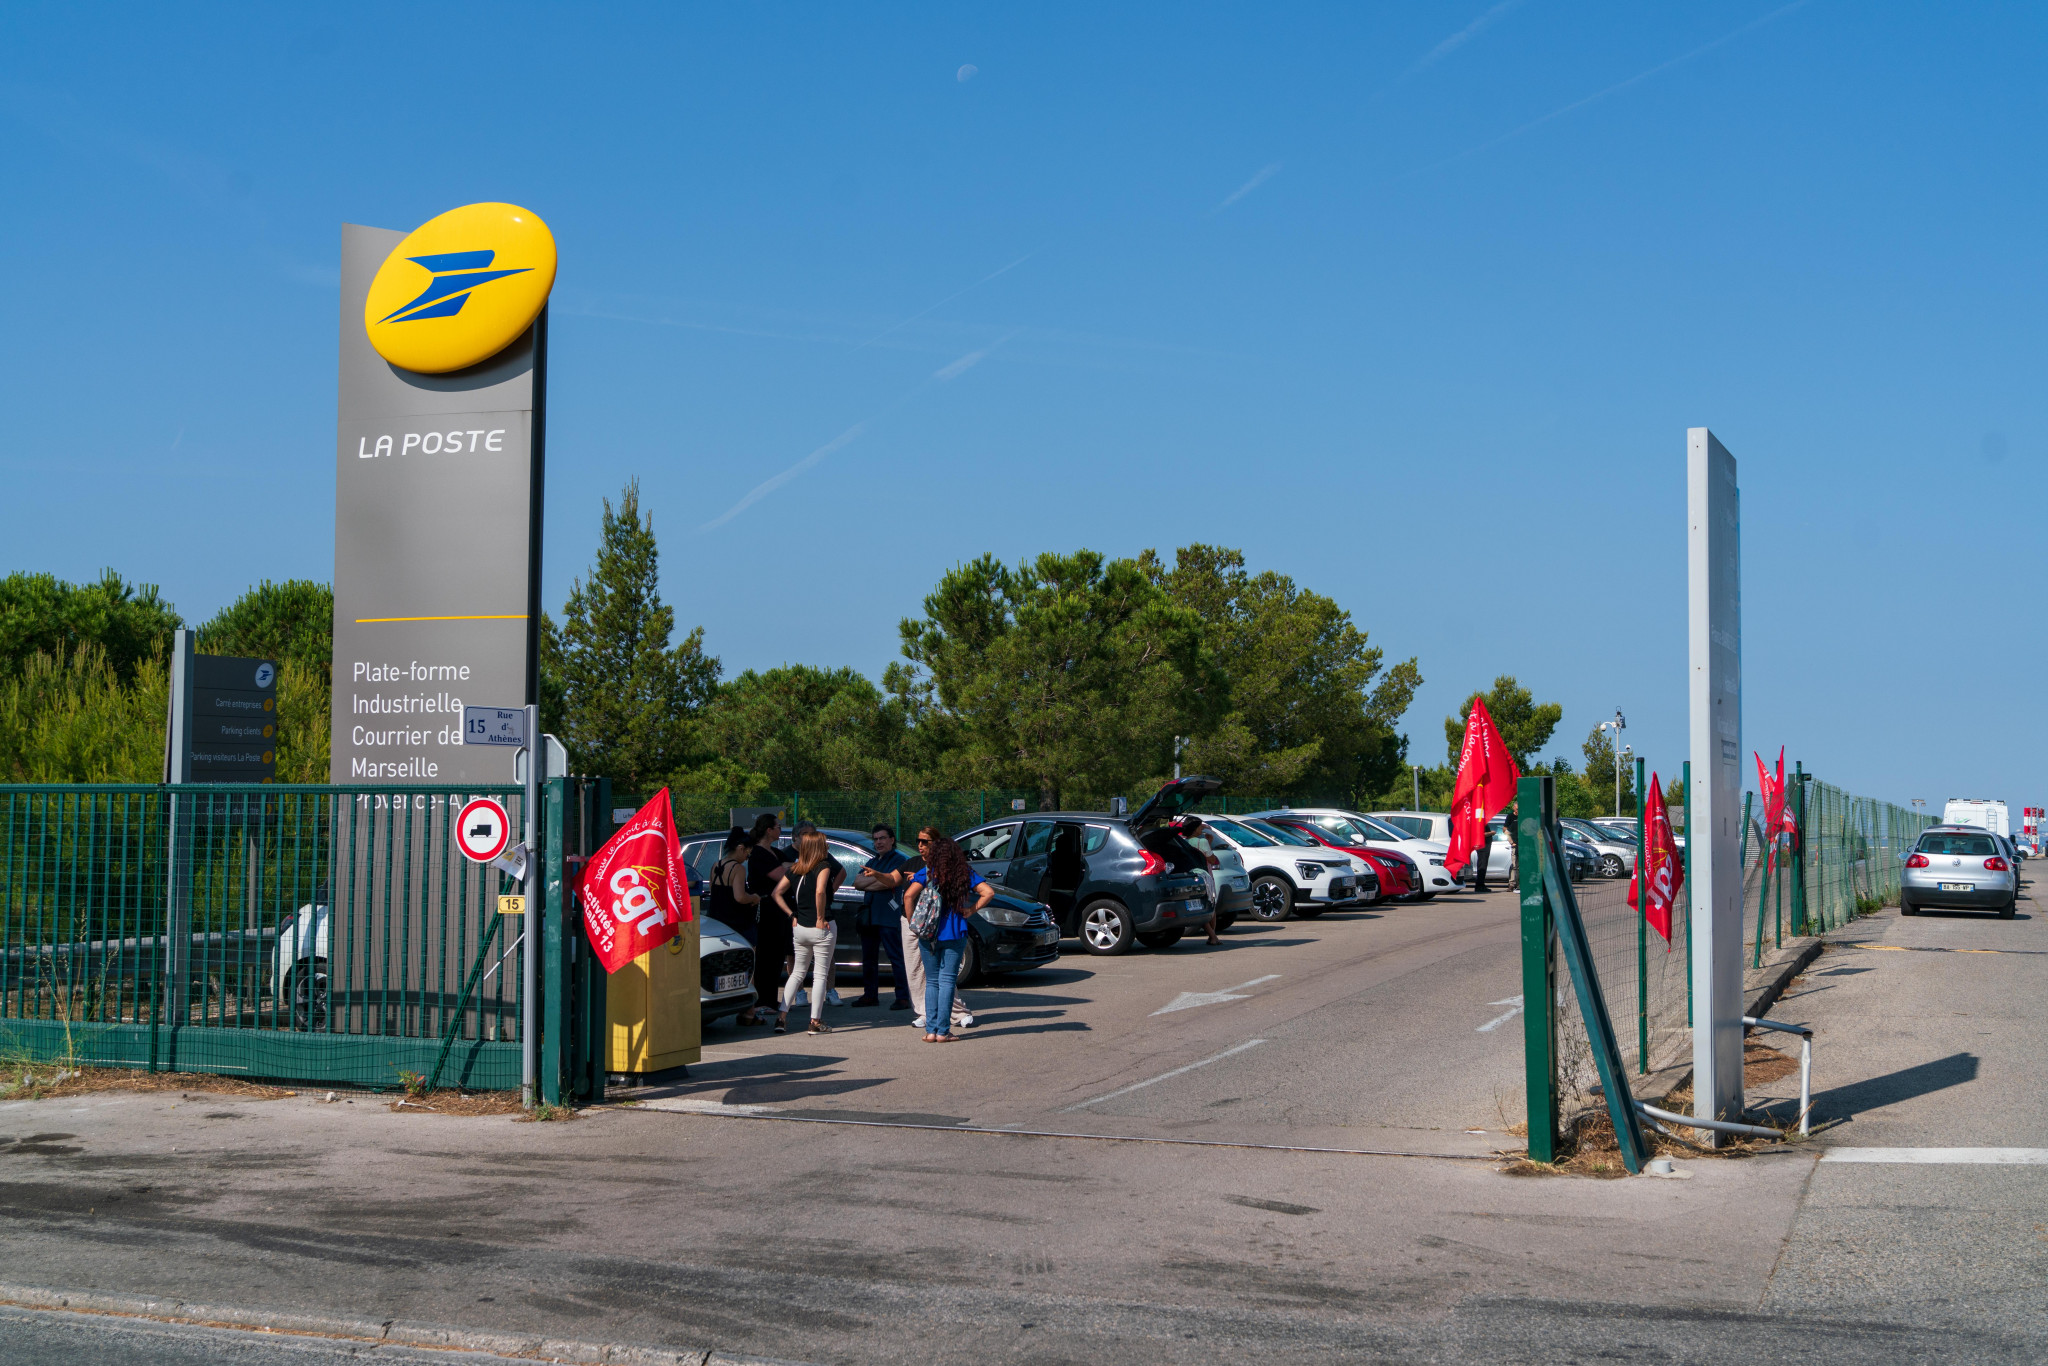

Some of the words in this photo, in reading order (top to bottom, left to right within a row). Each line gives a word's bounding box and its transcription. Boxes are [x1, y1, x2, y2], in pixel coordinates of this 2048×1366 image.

[359, 434, 394, 459] LA
[401, 429, 506, 456] POSTE
[353, 660, 471, 682] Plate-forme
[352, 692, 463, 714] Industrielle
[468, 718, 486, 734] 15
[497, 710, 514, 720] Rue
[221, 724, 243, 737] Parking
[352, 724, 432, 746] Courrier
[437, 724, 462, 746] de
[487, 734, 522, 744] Athènes
[351, 756, 439, 778] Marseille
[505, 898, 519, 910] 15
[583, 883, 616, 937] Activités
[609, 867, 666, 937] cgt
[600, 935, 614, 953] 13
